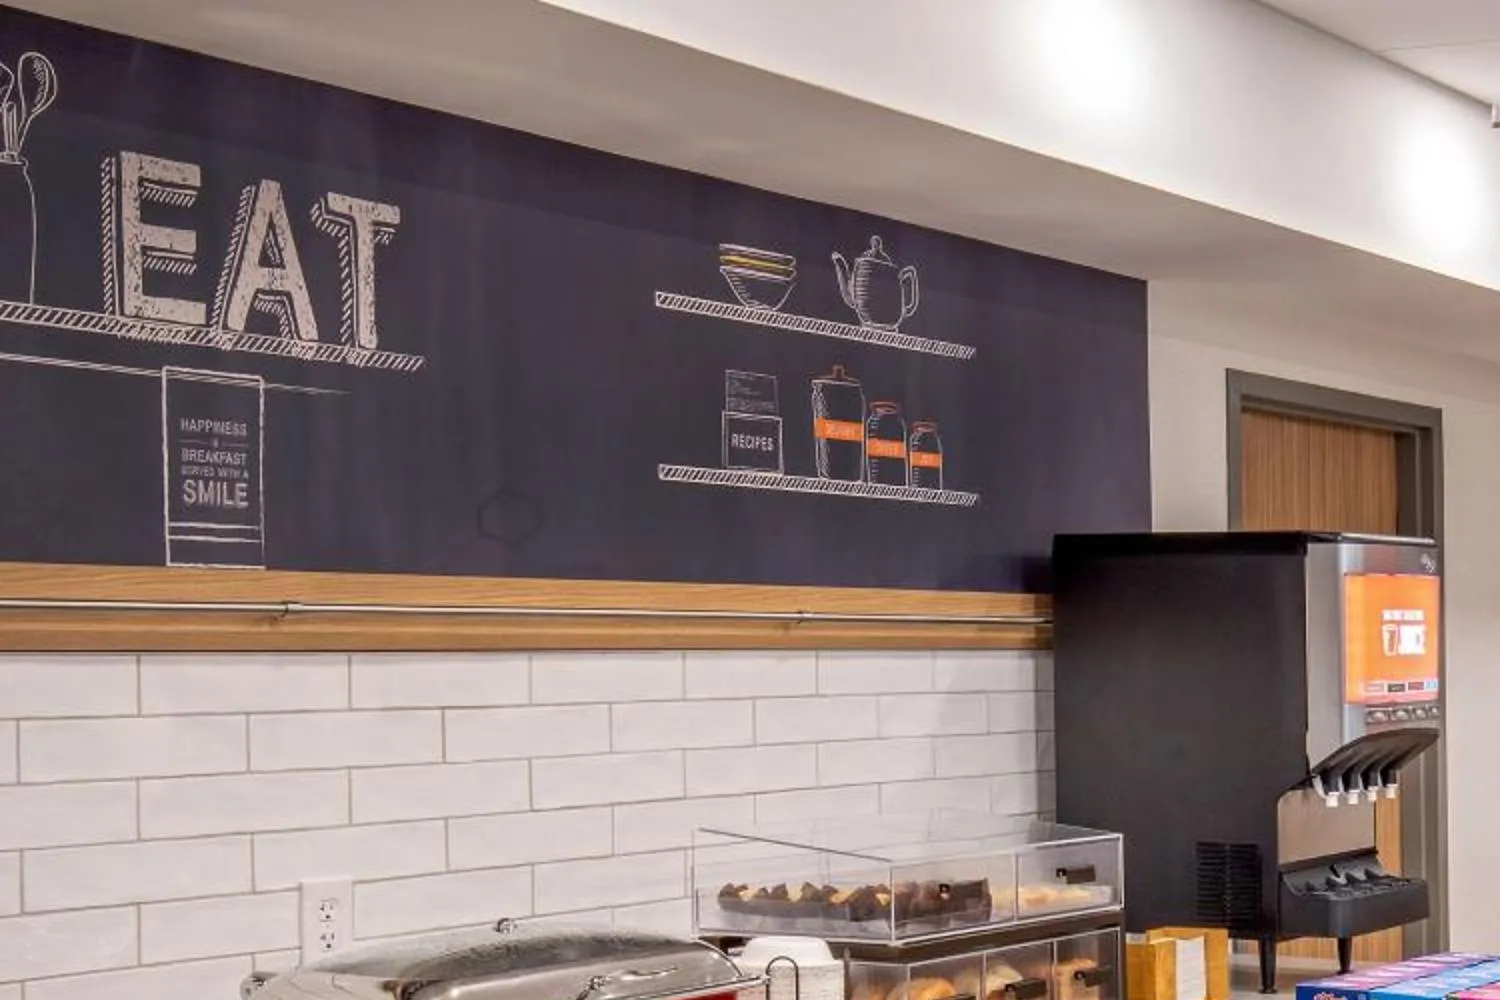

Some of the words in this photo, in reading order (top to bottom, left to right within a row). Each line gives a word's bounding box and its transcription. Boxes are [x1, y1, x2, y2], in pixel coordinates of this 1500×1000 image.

[102, 150, 402, 351] EAT
[180, 418, 248, 437] HAPPINESS
[730, 432, 775, 452] RECIPES
[181, 447, 249, 466] BREAKFAST
[183, 479, 249, 508] SMILE
